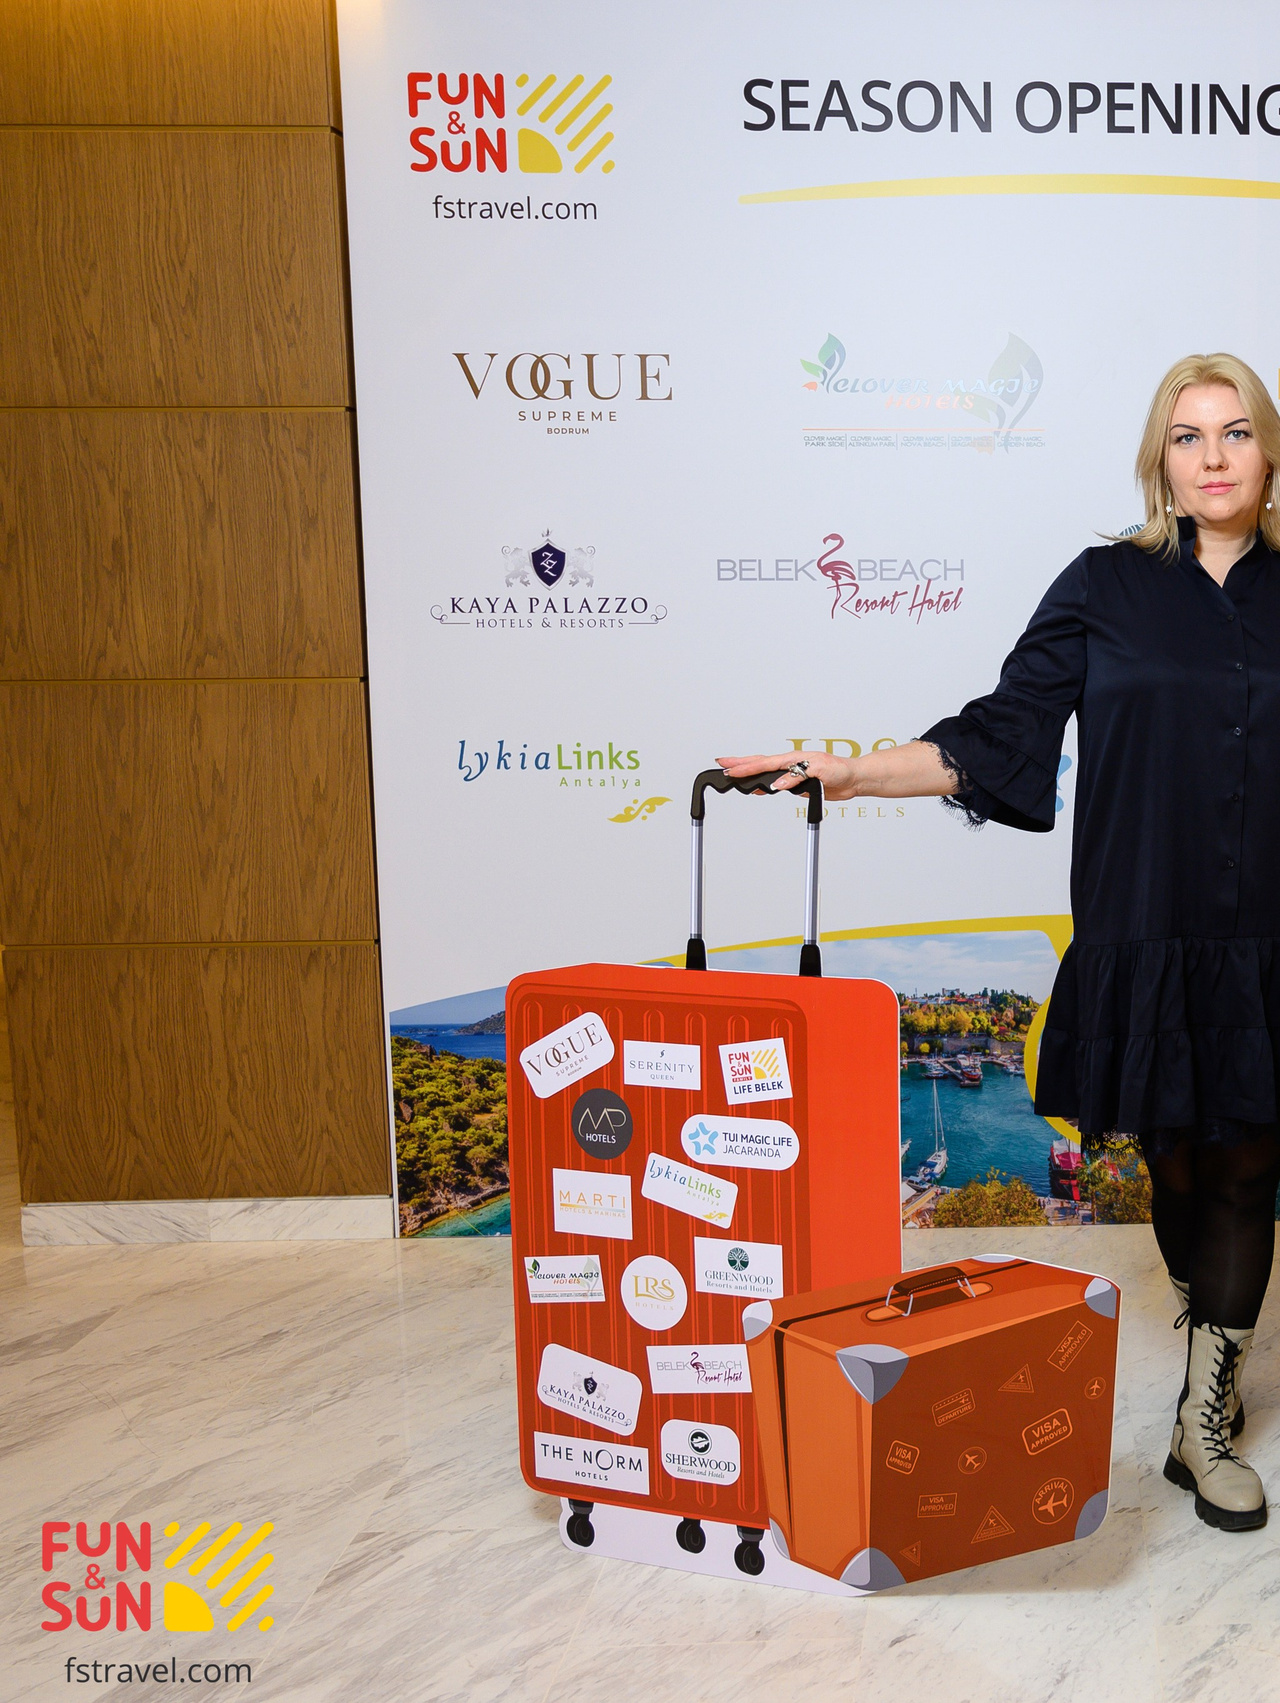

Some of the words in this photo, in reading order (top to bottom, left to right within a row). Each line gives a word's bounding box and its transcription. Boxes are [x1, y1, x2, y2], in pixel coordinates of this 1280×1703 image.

[407, 72, 505, 119] FUN
[742, 79, 992, 133] SEASON
[447, 111, 466, 134] &
[410, 127, 507, 173] SUN
[432, 195, 597, 220] fstravel.com
[452, 352, 673, 401] VOGUE
[833, 377, 929, 394] CLOVER
[940, 378, 1040, 395] MAGIC
[884, 394, 975, 410] HOTELS
[518, 410, 618, 422] SUPREME
[546, 427, 590, 435] BODRUM
[717, 559, 818, 581] BELEK
[857, 559, 965, 581] BEACH
[450, 597, 519, 614] KAYA
[528, 597, 649, 614] PALAZZO
[827, 582, 908, 619] Resort
[908, 579, 963, 625] Hotel
[475, 618, 534, 628] HOTELS
[541, 618, 552, 628] &
[560, 618, 624, 628] RESORTS
[559, 776, 641, 789] Antalya
[526, 1022, 603, 1076] VOGUE
[728, 1051, 750, 1064] FUN
[555, 1055, 589, 1077] SUPREME
[629, 1060, 695, 1074] SERENITY
[730, 1064, 752, 1077] SUN
[650, 1073, 675, 1081] QUEEN
[733, 1084, 753, 1095] LIFE
[755, 1081, 784, 1092] BELEK
[578, 1107, 627, 1138] MP
[585, 1133, 616, 1144] HOTELS
[722, 1132, 738, 1142] TUI
[740, 1133, 770, 1145] MAGIC
[772, 1136, 792, 1147] LIFE
[722, 1144, 781, 1158] JACARANDA
[559, 1189, 626, 1209] MARTI
[687, 1189, 720, 1207] Antalya
[559, 1206, 586, 1214] HOTELS
[594, 1209, 626, 1218] MARINAS
[569, 1271, 599, 1279] MAGIC
[705, 1269, 774, 1286] GREENWOOD
[632, 1275, 675, 1302] LRS
[706, 1280, 733, 1289] Resorts
[734, 1283, 748, 1291] and
[749, 1285, 773, 1294] Hotels
[635, 1302, 674, 1311] HOTELS
[1058, 1336, 1074, 1353] VISA
[1058, 1328, 1087, 1366] APPROVED
[656, 1361, 691, 1371] BELEK
[704, 1360, 742, 1370] BEACH
[723, 1368, 743, 1387] Hotel
[549, 1384, 576, 1401] KAYA
[578, 1395, 625, 1421] PALAZZO
[557, 1397, 580, 1411] HOTELS
[589, 1409, 615, 1424] RESORTS
[938, 1404, 972, 1424] DEPARTURE
[1032, 1418, 1061, 1438] VISA
[1031, 1425, 1068, 1450] APPROVED
[541, 1443, 574, 1461] THE
[583, 1449, 643, 1472] NORM
[895, 1446, 912, 1460] VISA
[665, 1452, 737, 1473] SHERWOOD
[889, 1456, 912, 1469] APPROVED
[575, 1470, 608, 1481] HOTELS
[696, 1469, 707, 1477] and
[1035, 1481, 1068, 1504] ARRIVAL
[920, 1503, 954, 1512] APPROVED
